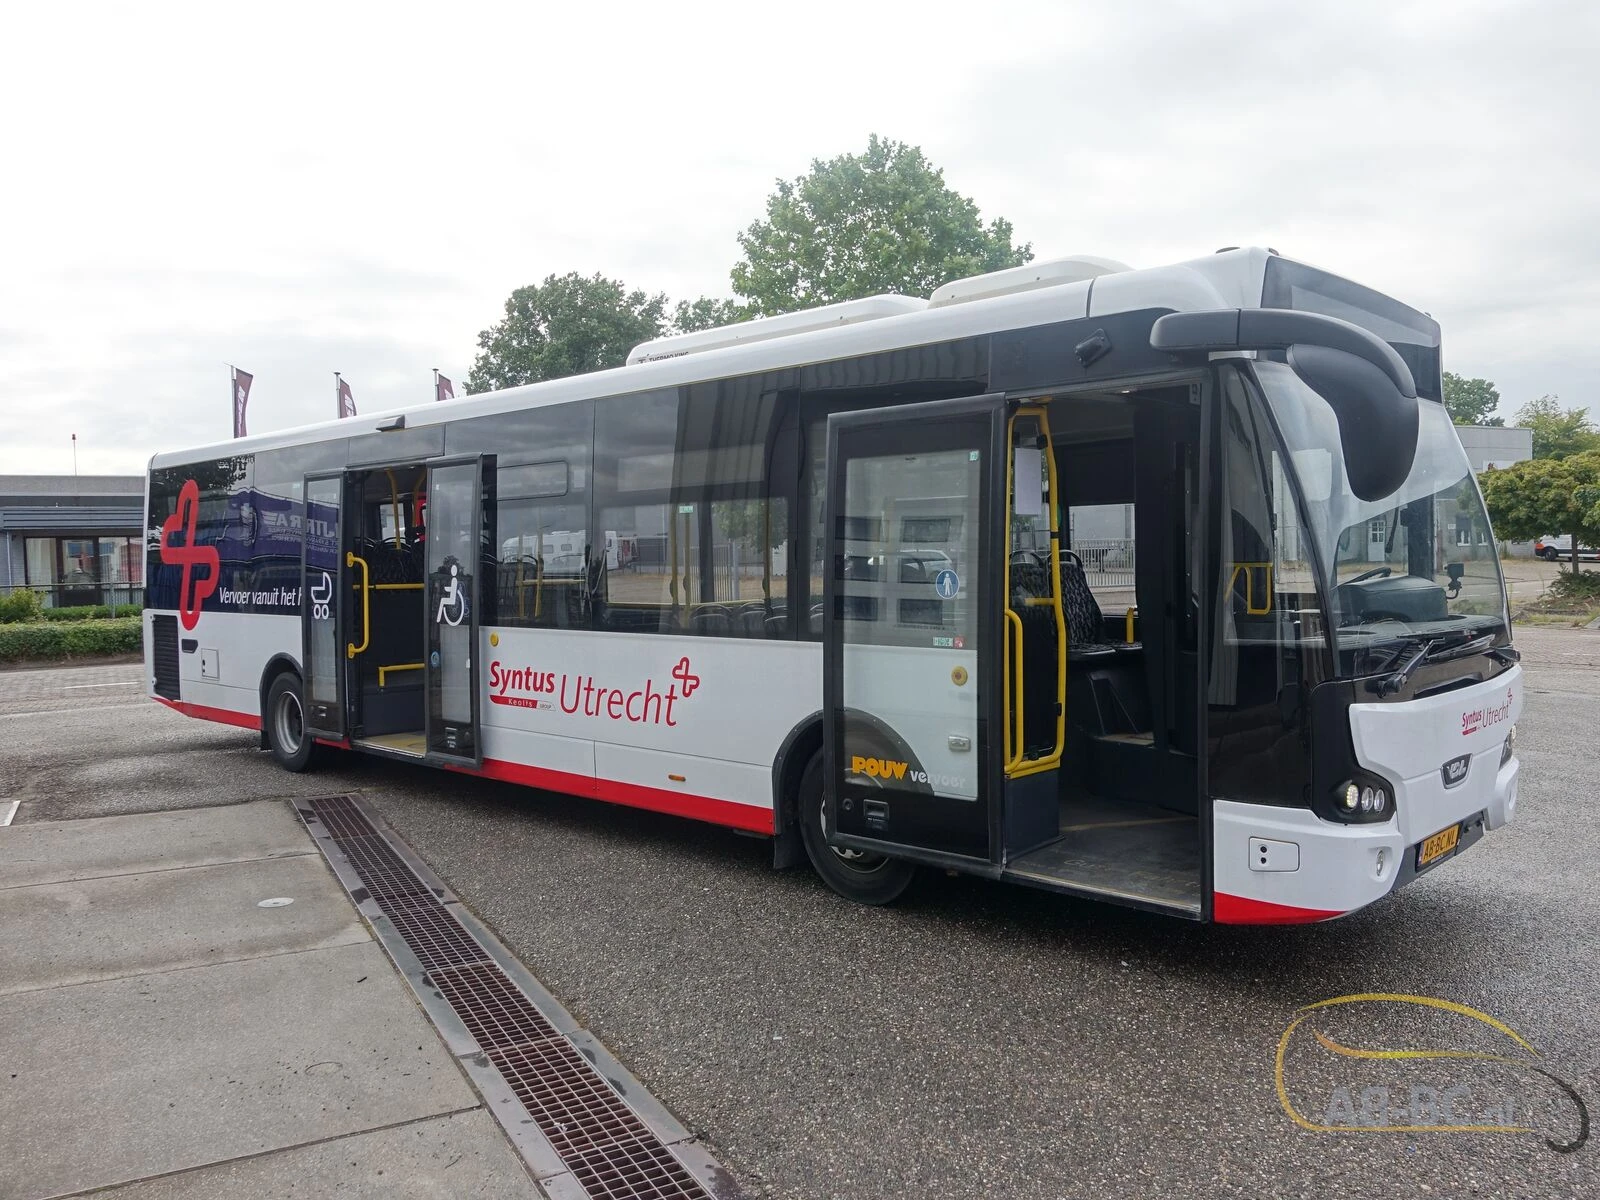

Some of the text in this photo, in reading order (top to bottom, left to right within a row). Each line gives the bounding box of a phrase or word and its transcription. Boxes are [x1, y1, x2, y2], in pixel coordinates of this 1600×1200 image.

[219, 587, 251, 604] Vervoer
[252, 588, 279, 605] vanuit
[280, 586, 296, 606] het
[489, 661, 678, 726] Syntus Utrecht
[508, 698, 533, 708] Keolis
[1462, 700, 1509, 729] Syntus Utrecht
[852, 756, 966, 788] POUW vervoer
